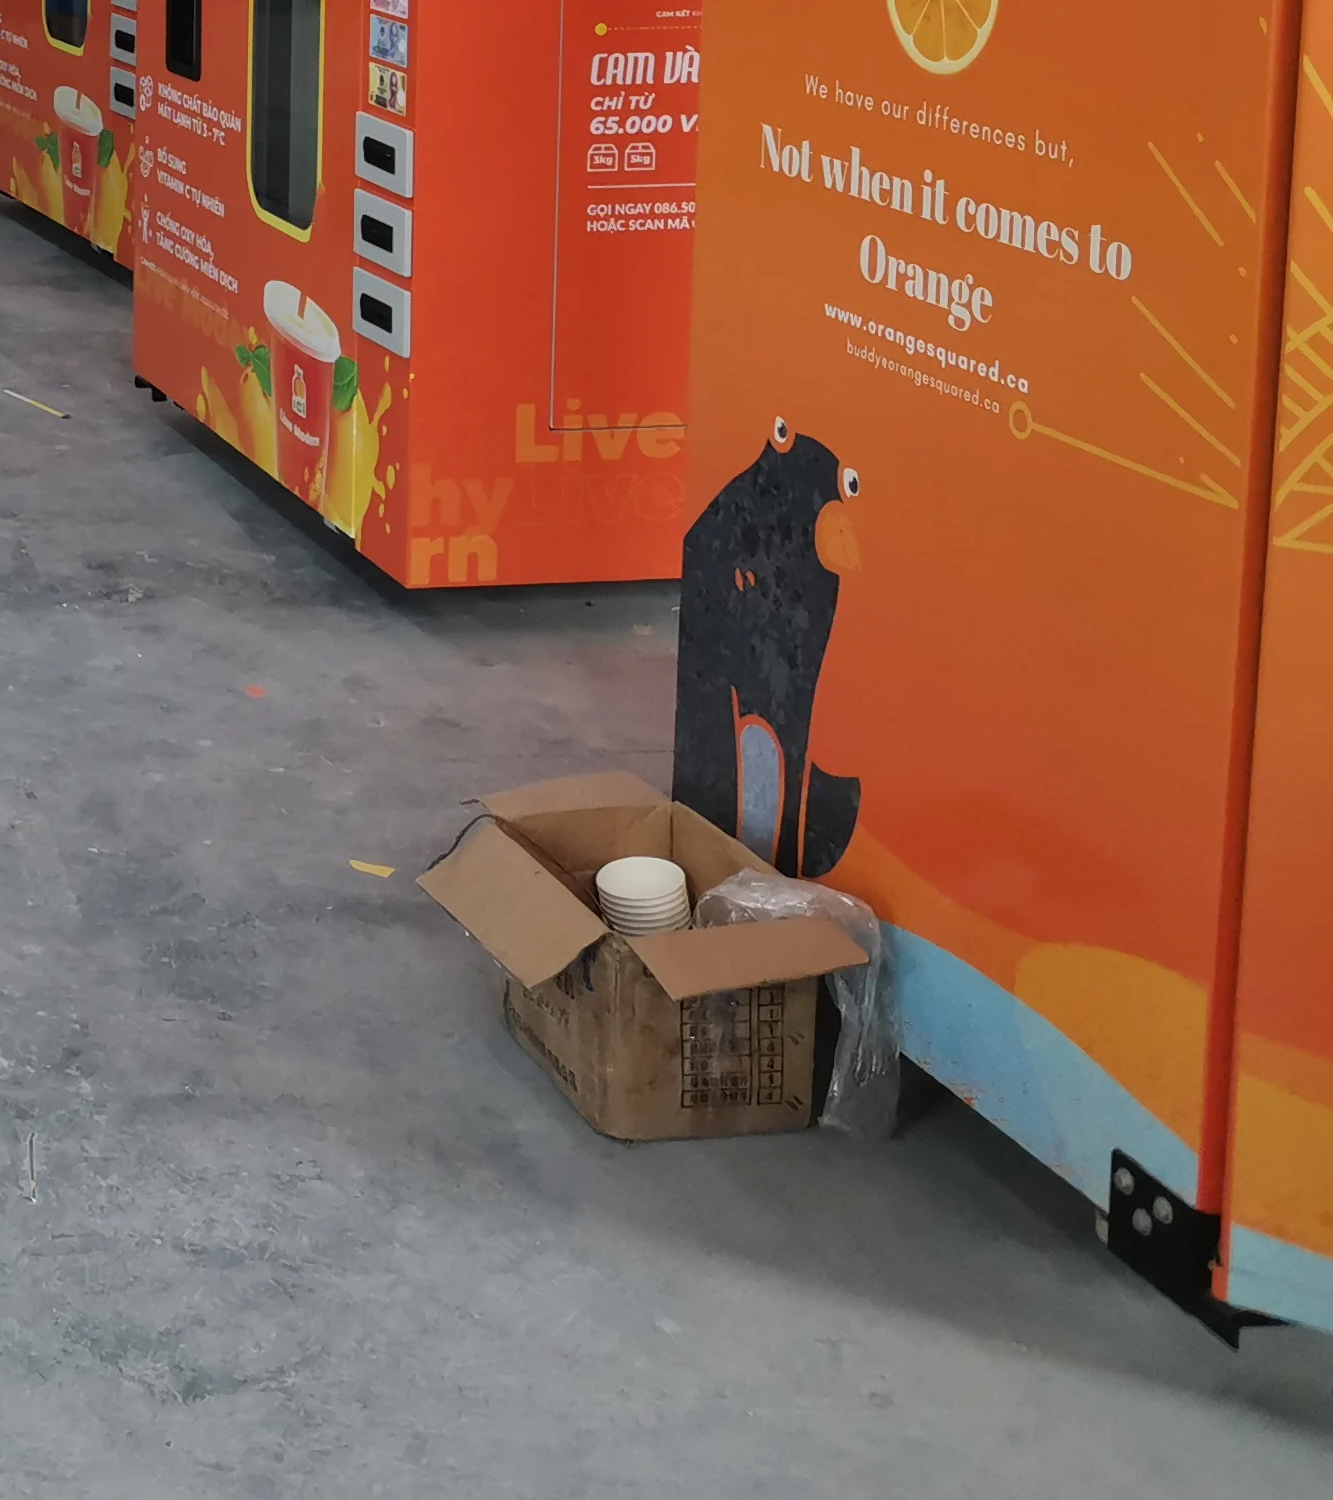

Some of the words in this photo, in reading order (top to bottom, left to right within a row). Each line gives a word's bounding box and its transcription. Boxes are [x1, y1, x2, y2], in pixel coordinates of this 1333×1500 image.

[590, 52, 655, 86] CAM
[158, 82, 182, 105] KHÔNG
[183, 94, 202, 114] CHẤT
[203, 100, 218, 122] BẢO
[220, 110, 242, 133] QUẢN
[591, 91, 625, 111] CHỈ
[629, 92, 656, 110] TỪ
[157, 101, 172, 119] MÁT
[192, 116, 202, 135] TỪ
[590, 114, 673, 135] 65.000
[804, 72, 829, 100] We
[834, 79, 874, 112] have
[881, 98, 910, 121] our
[916, 101, 1026, 152] differences
[1034, 129, 1075, 169] but,
[168, 154, 187, 175] SUNG
[593, 155, 613, 165] 3kg
[630, 154, 650, 165] 5kg
[157, 168, 184, 195] VITAMIN
[202, 195, 225, 218] NHIÊN
[759, 122, 814, 183] Not
[820, 145, 914, 215] when
[920, 169, 950, 226] it
[955, 194, 1080, 266] comes
[1088, 223, 1133, 281] to
[156, 211, 181, 238] CHỐNG
[587, 204, 611, 218] GỌI
[615, 203, 652, 215] NGAY
[587, 219, 625, 234] HOẶC
[629, 219, 664, 231] SCAN
[668, 216, 690, 229] MÃ
[219, 273, 239, 294] DỊCH
[859, 234, 993, 333] Orange
[824, 301, 1030, 395] www.orangesquared.ca
[846, 337, 1001, 415] buddy@orangesquared.ca
